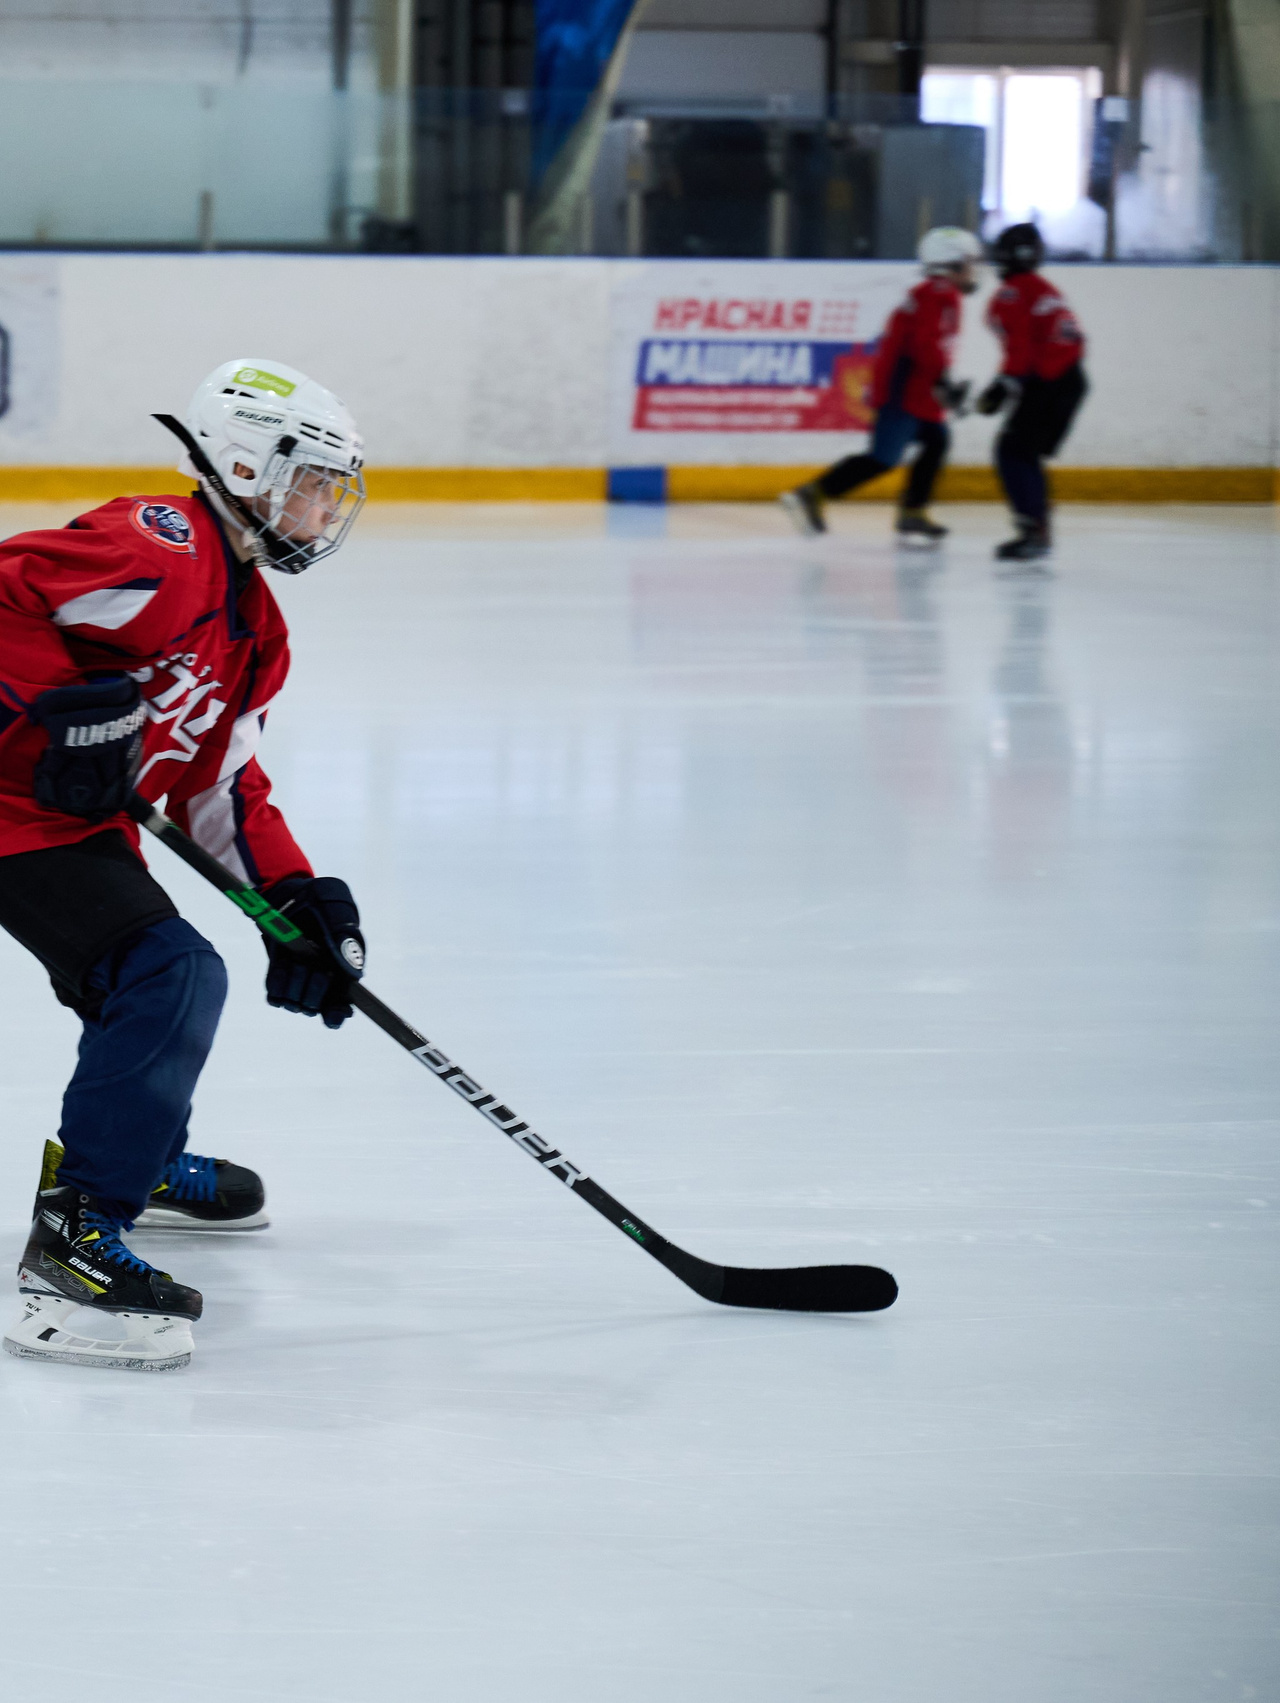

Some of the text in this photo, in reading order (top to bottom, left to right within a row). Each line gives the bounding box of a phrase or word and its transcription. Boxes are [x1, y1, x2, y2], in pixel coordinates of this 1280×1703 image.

[643, 344, 814, 386] МАШИНА
[410, 1041, 589, 1187] BAUER
[68, 1256, 113, 1286] BAUER
